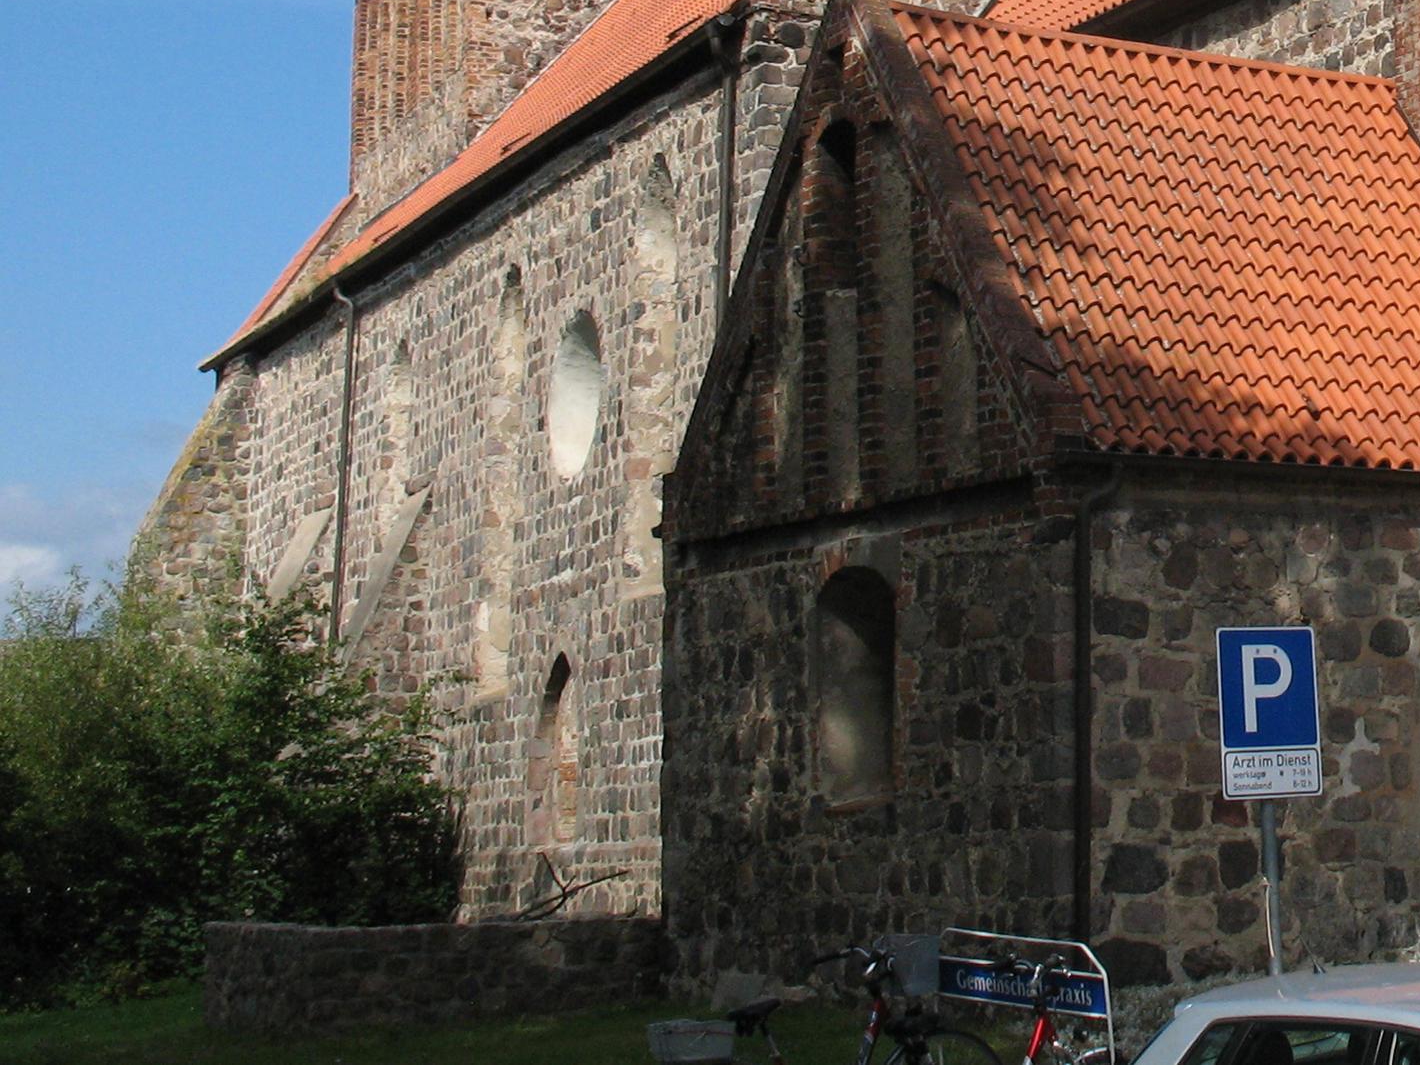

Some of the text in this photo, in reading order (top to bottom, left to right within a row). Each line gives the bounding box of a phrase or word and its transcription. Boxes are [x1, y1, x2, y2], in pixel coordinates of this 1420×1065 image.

[1241, 644, 1293, 732] P
[1232, 753, 1311, 768] Arzt im Dienst
